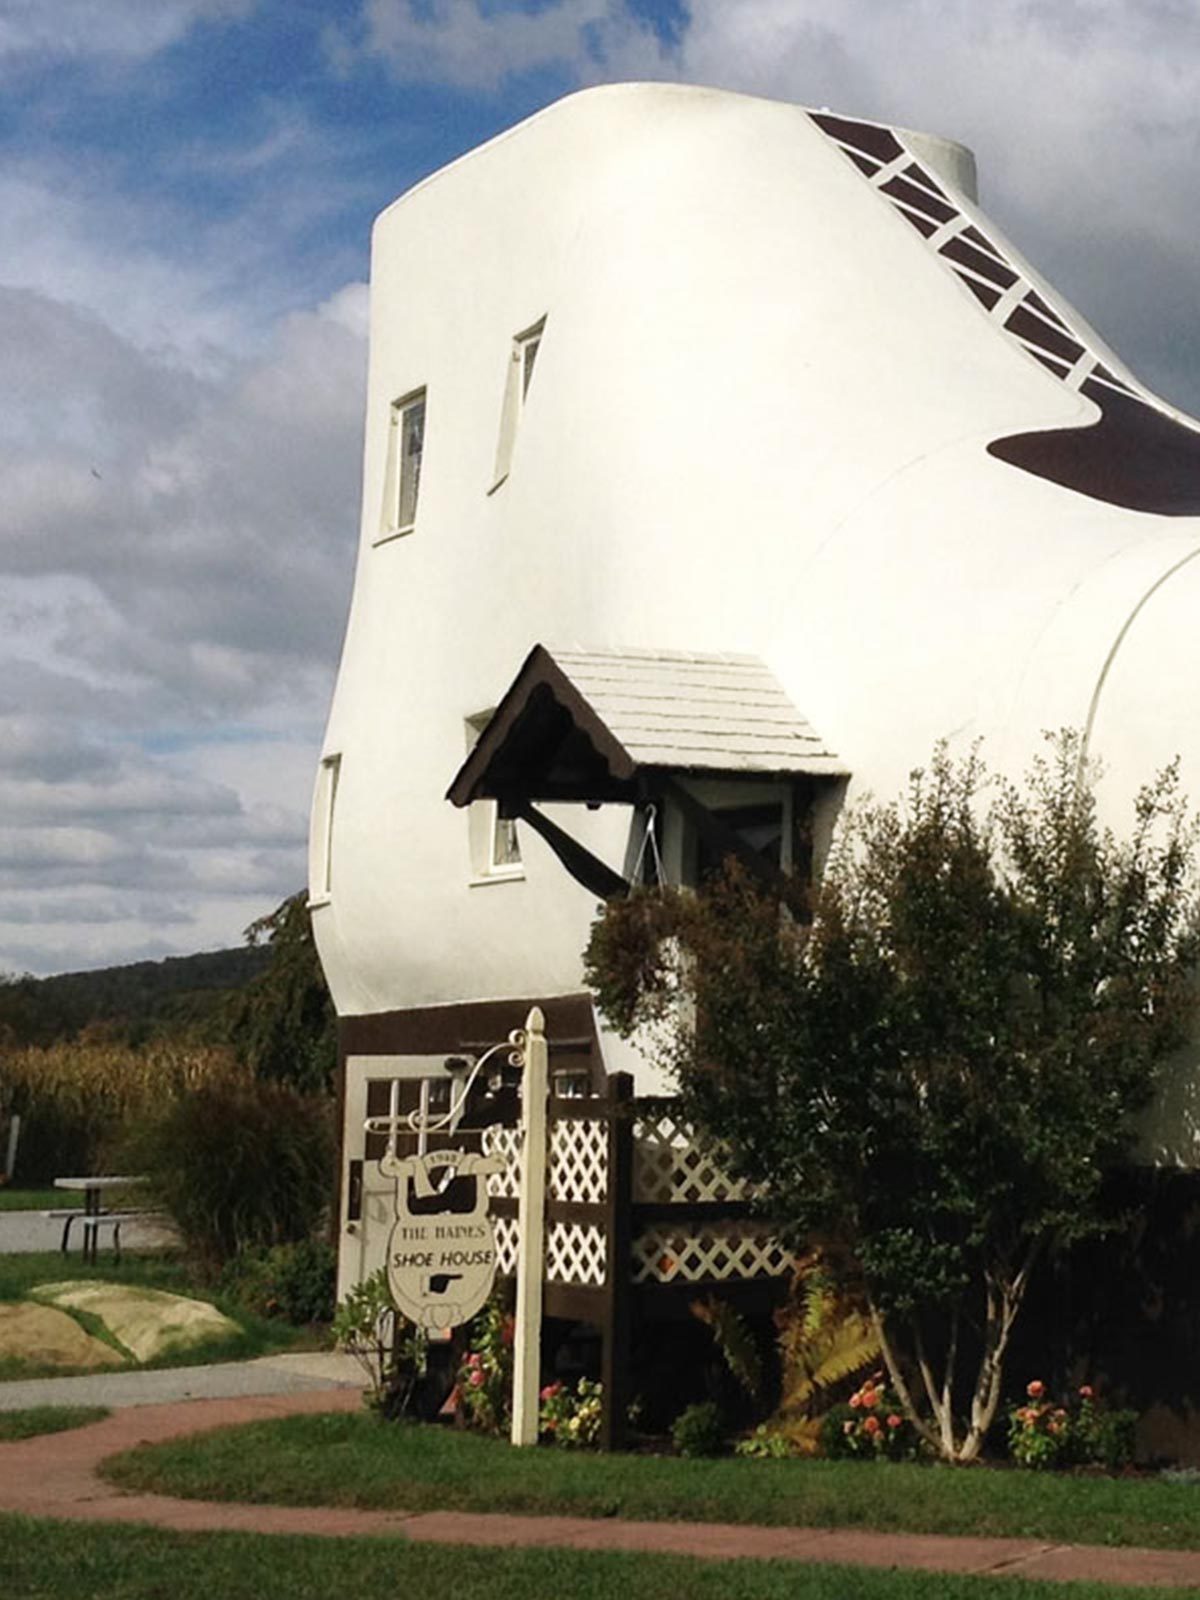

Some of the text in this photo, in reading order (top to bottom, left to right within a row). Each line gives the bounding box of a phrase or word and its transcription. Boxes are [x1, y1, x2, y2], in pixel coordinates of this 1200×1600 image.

[402, 1225, 486, 1240] THE HAINES
[393, 1250, 492, 1268] SHOE HOUSE
